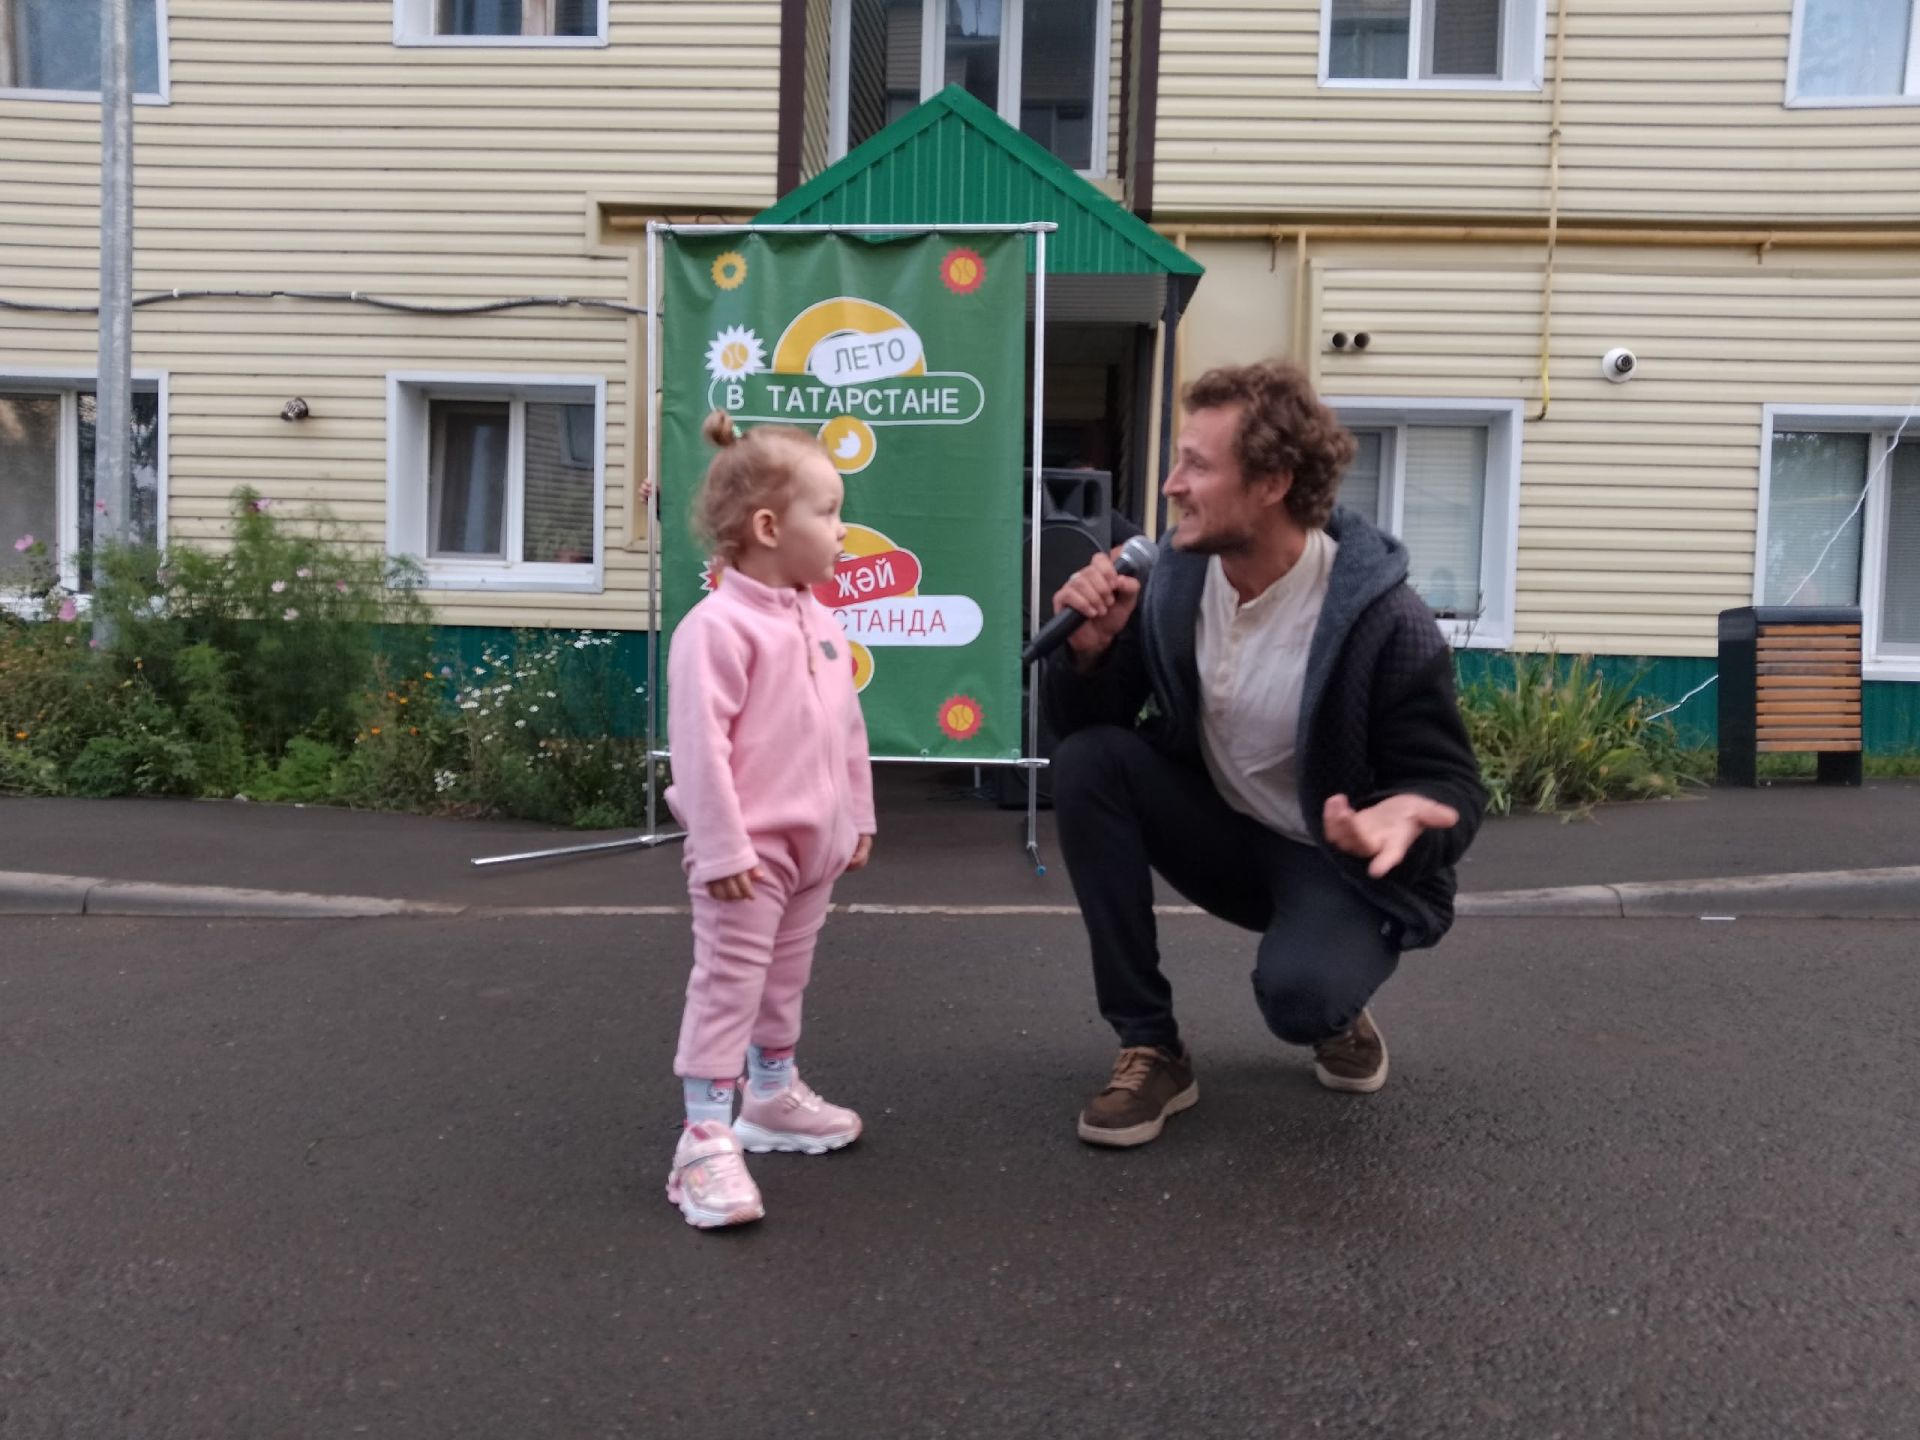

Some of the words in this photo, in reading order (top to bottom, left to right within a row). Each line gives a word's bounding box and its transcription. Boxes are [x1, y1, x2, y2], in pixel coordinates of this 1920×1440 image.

[834, 338, 905, 374] ЛЕТО
[726, 385, 744, 410] В
[766, 385, 959, 415] ТАТАРСТАНЕ
